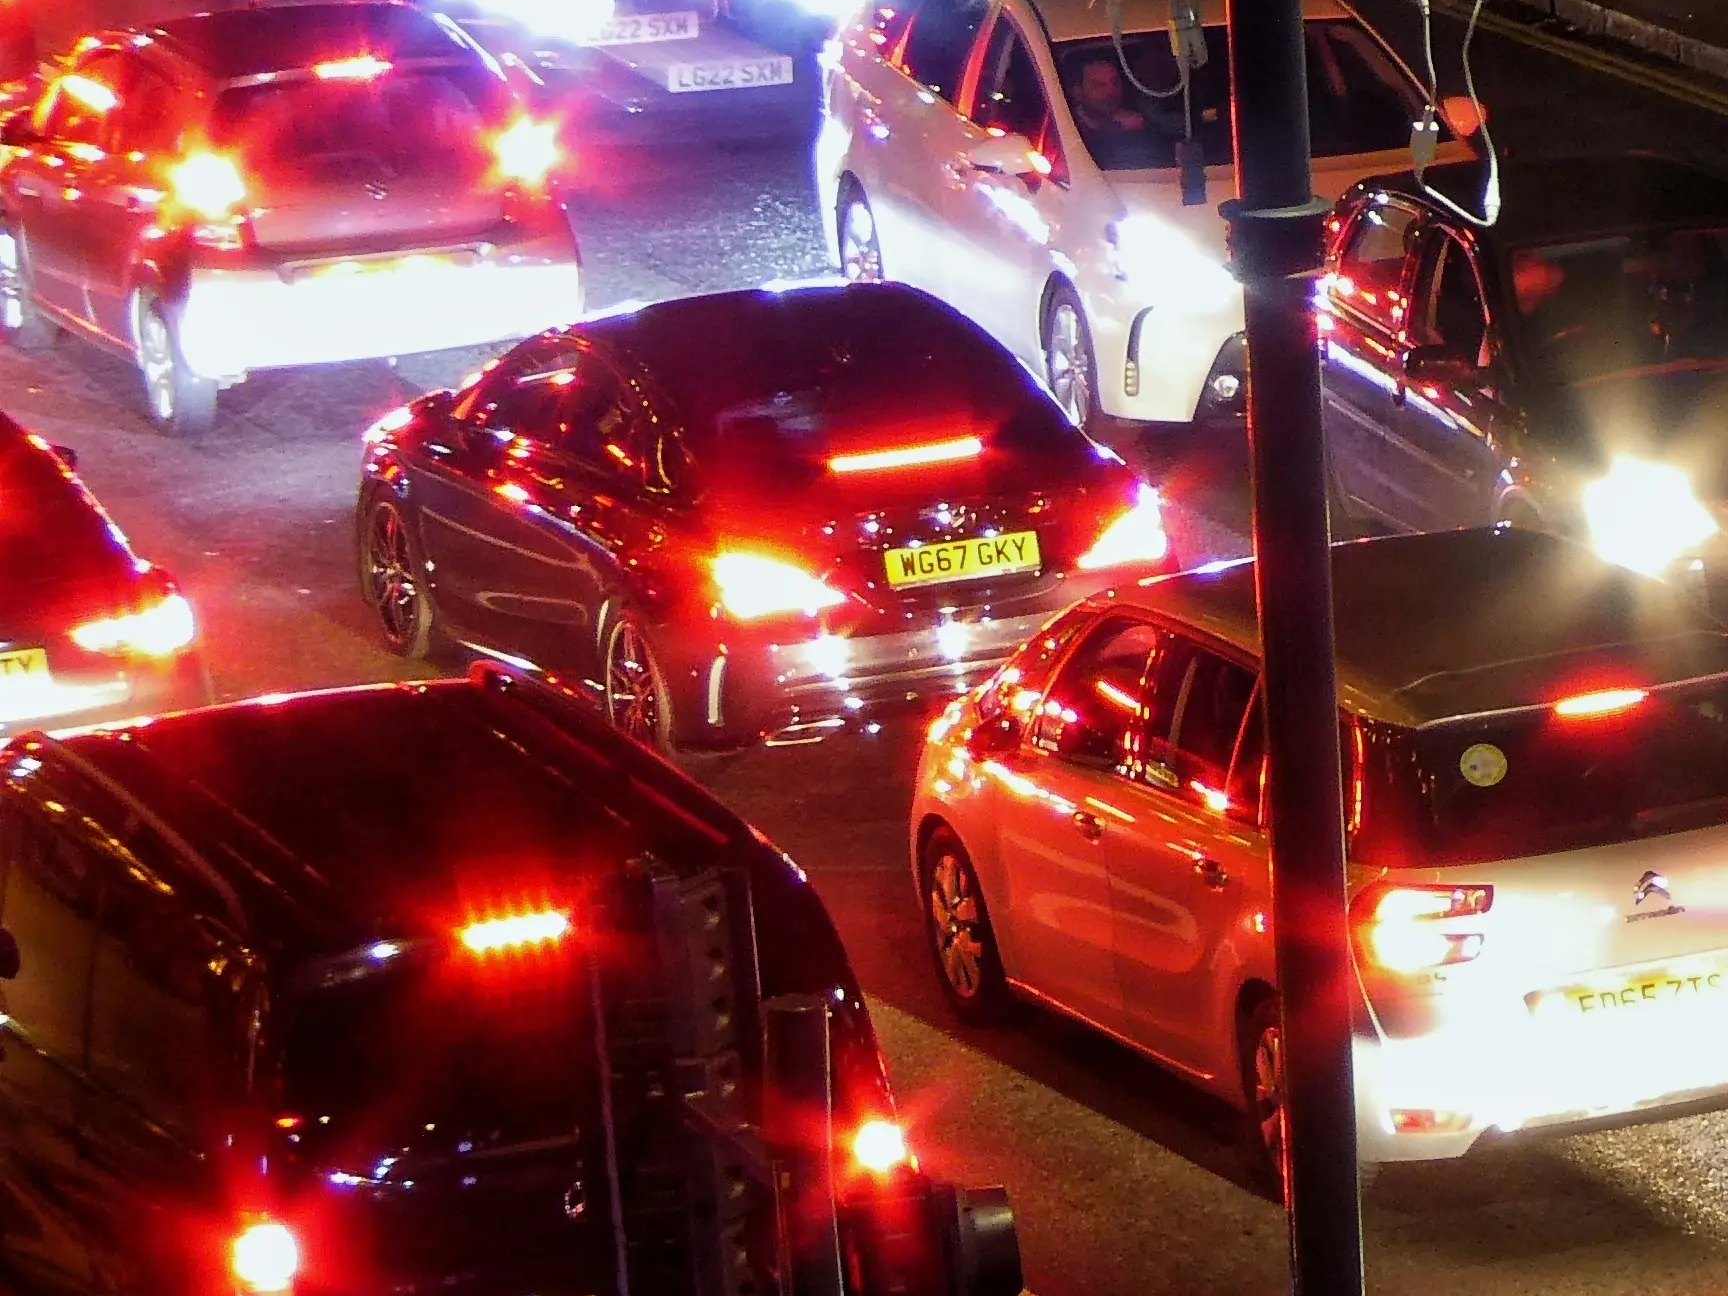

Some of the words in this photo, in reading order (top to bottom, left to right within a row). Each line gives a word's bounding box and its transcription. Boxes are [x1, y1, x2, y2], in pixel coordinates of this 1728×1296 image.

[589, 20, 642, 41] G22
[900, 545, 967, 577] WG67
[977, 537, 1025, 566] GKY
